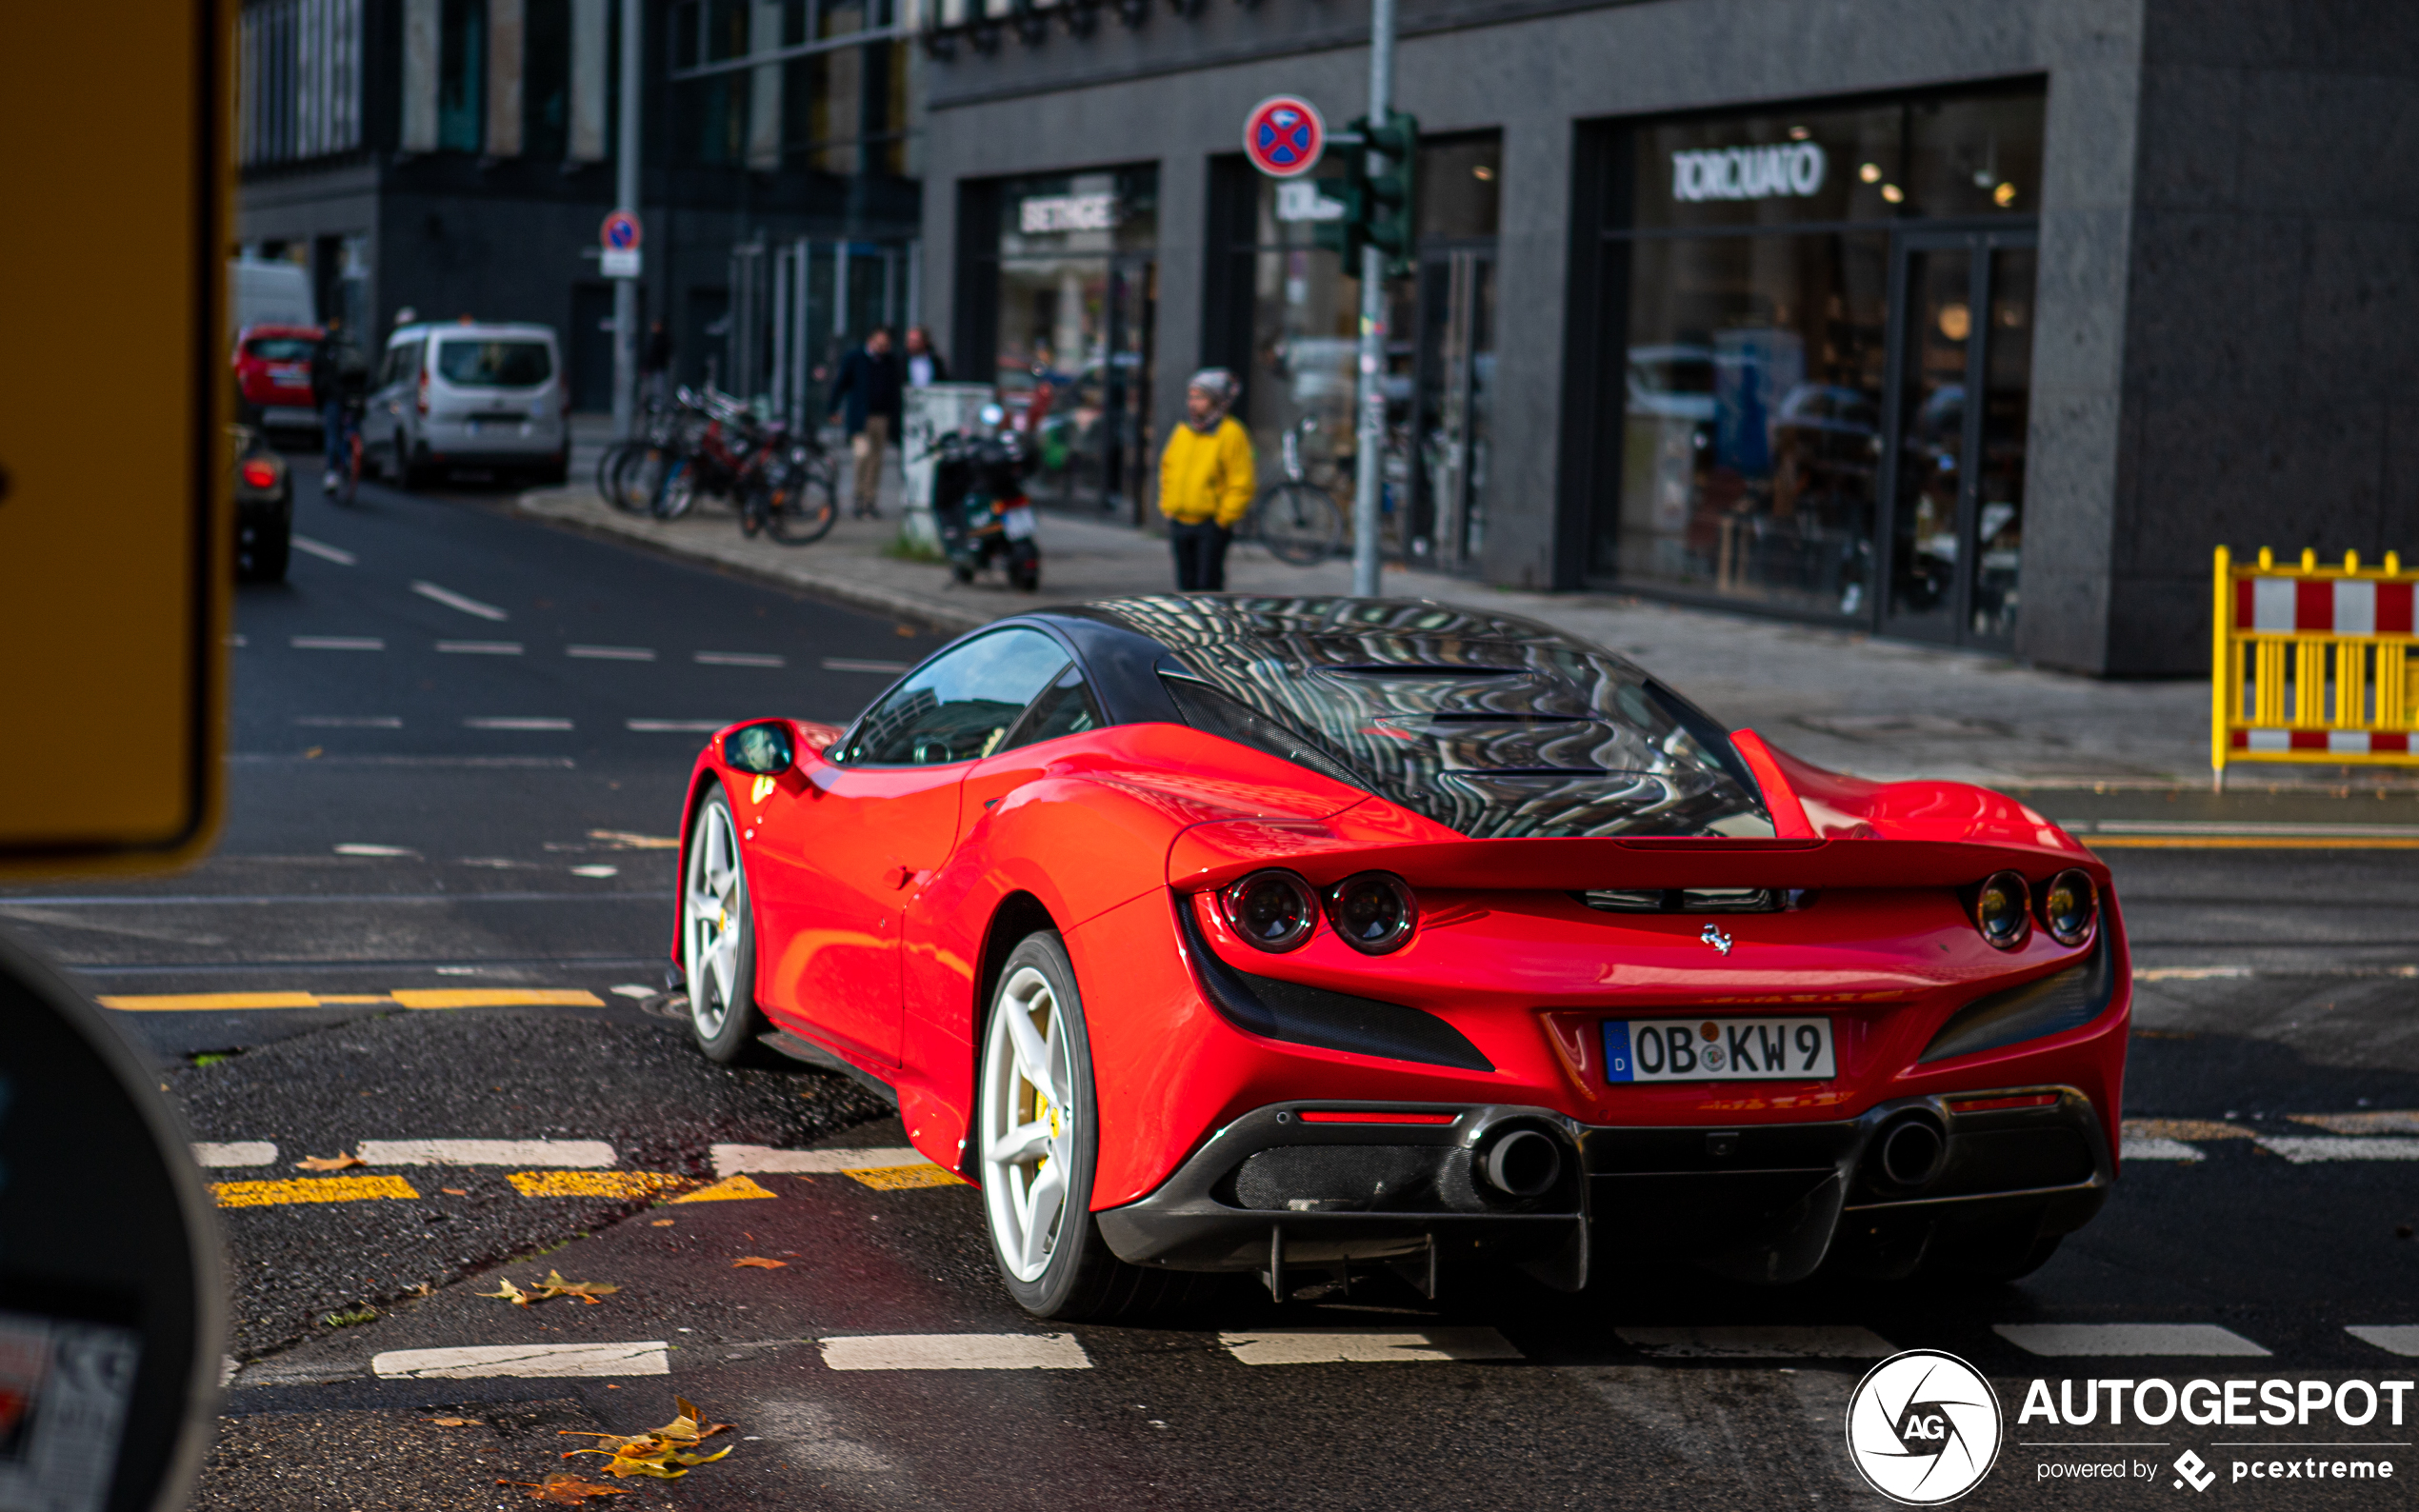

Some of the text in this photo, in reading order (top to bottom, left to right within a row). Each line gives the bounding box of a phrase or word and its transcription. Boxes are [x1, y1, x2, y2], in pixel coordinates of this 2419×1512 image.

[1673, 143, 1824, 200] TORQUATO
[1615, 1058, 1625, 1071] D
[1636, 1025, 1821, 1073] OB KW 9
